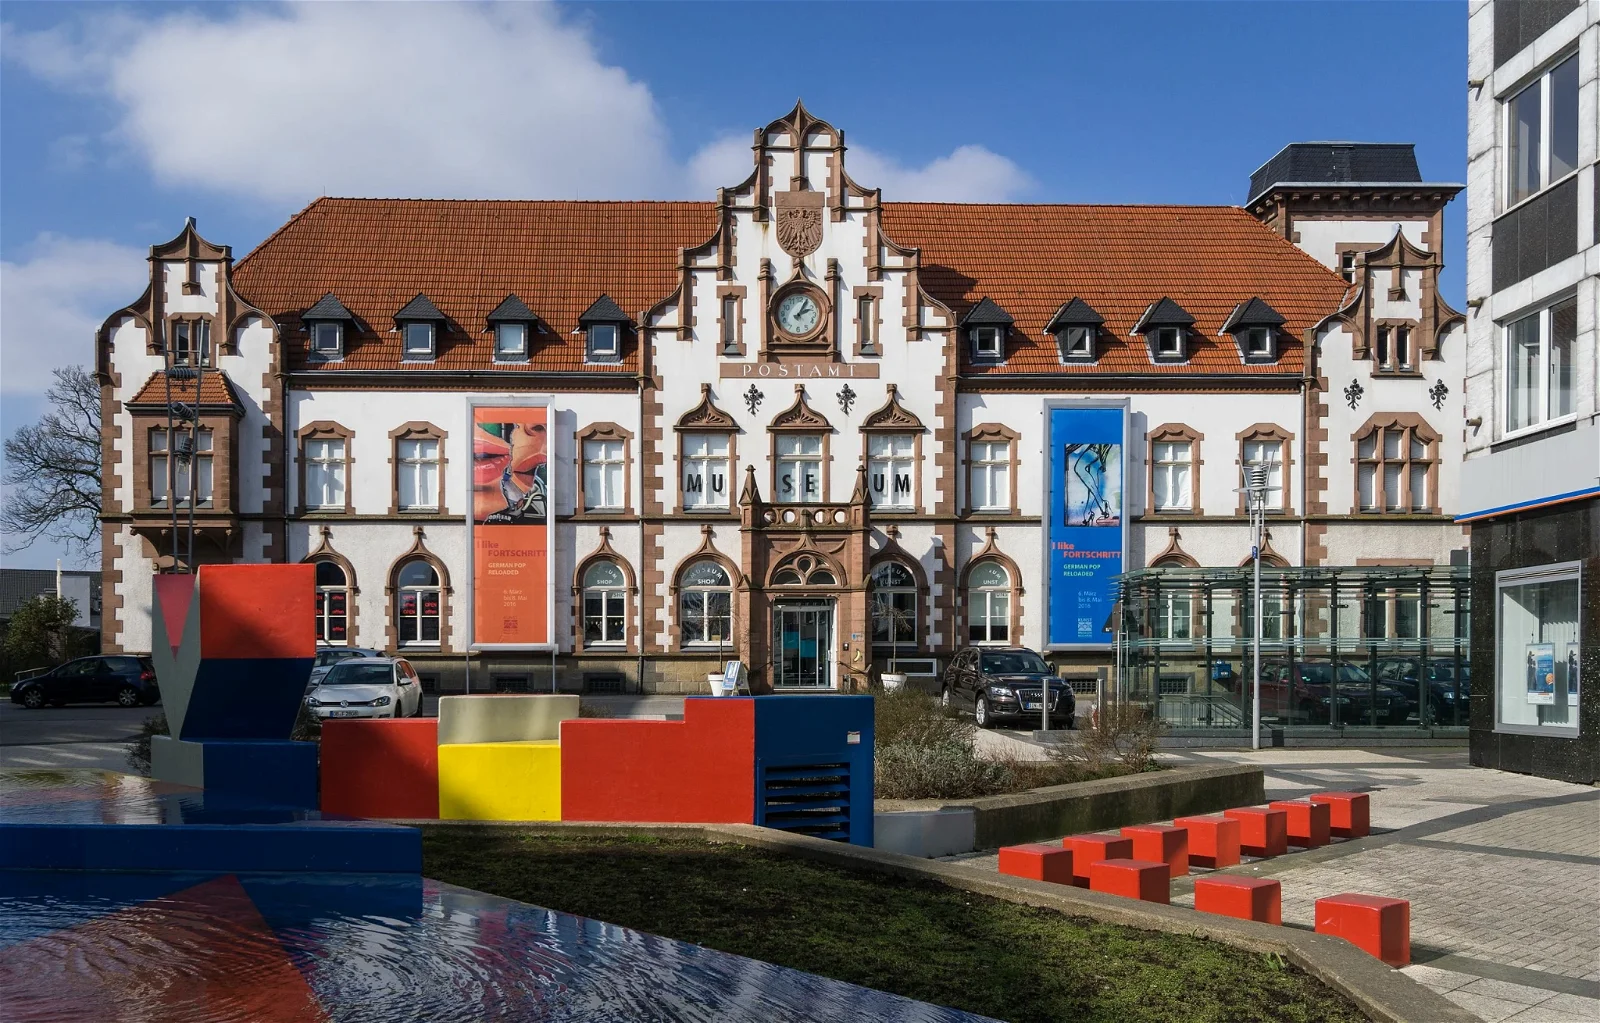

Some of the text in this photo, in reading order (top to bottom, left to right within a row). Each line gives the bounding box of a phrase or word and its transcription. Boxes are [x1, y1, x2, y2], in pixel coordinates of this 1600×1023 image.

[743, 364, 856, 376] POSTAMT
[482, 540, 499, 548] like
[1058, 542, 1075, 550] like
